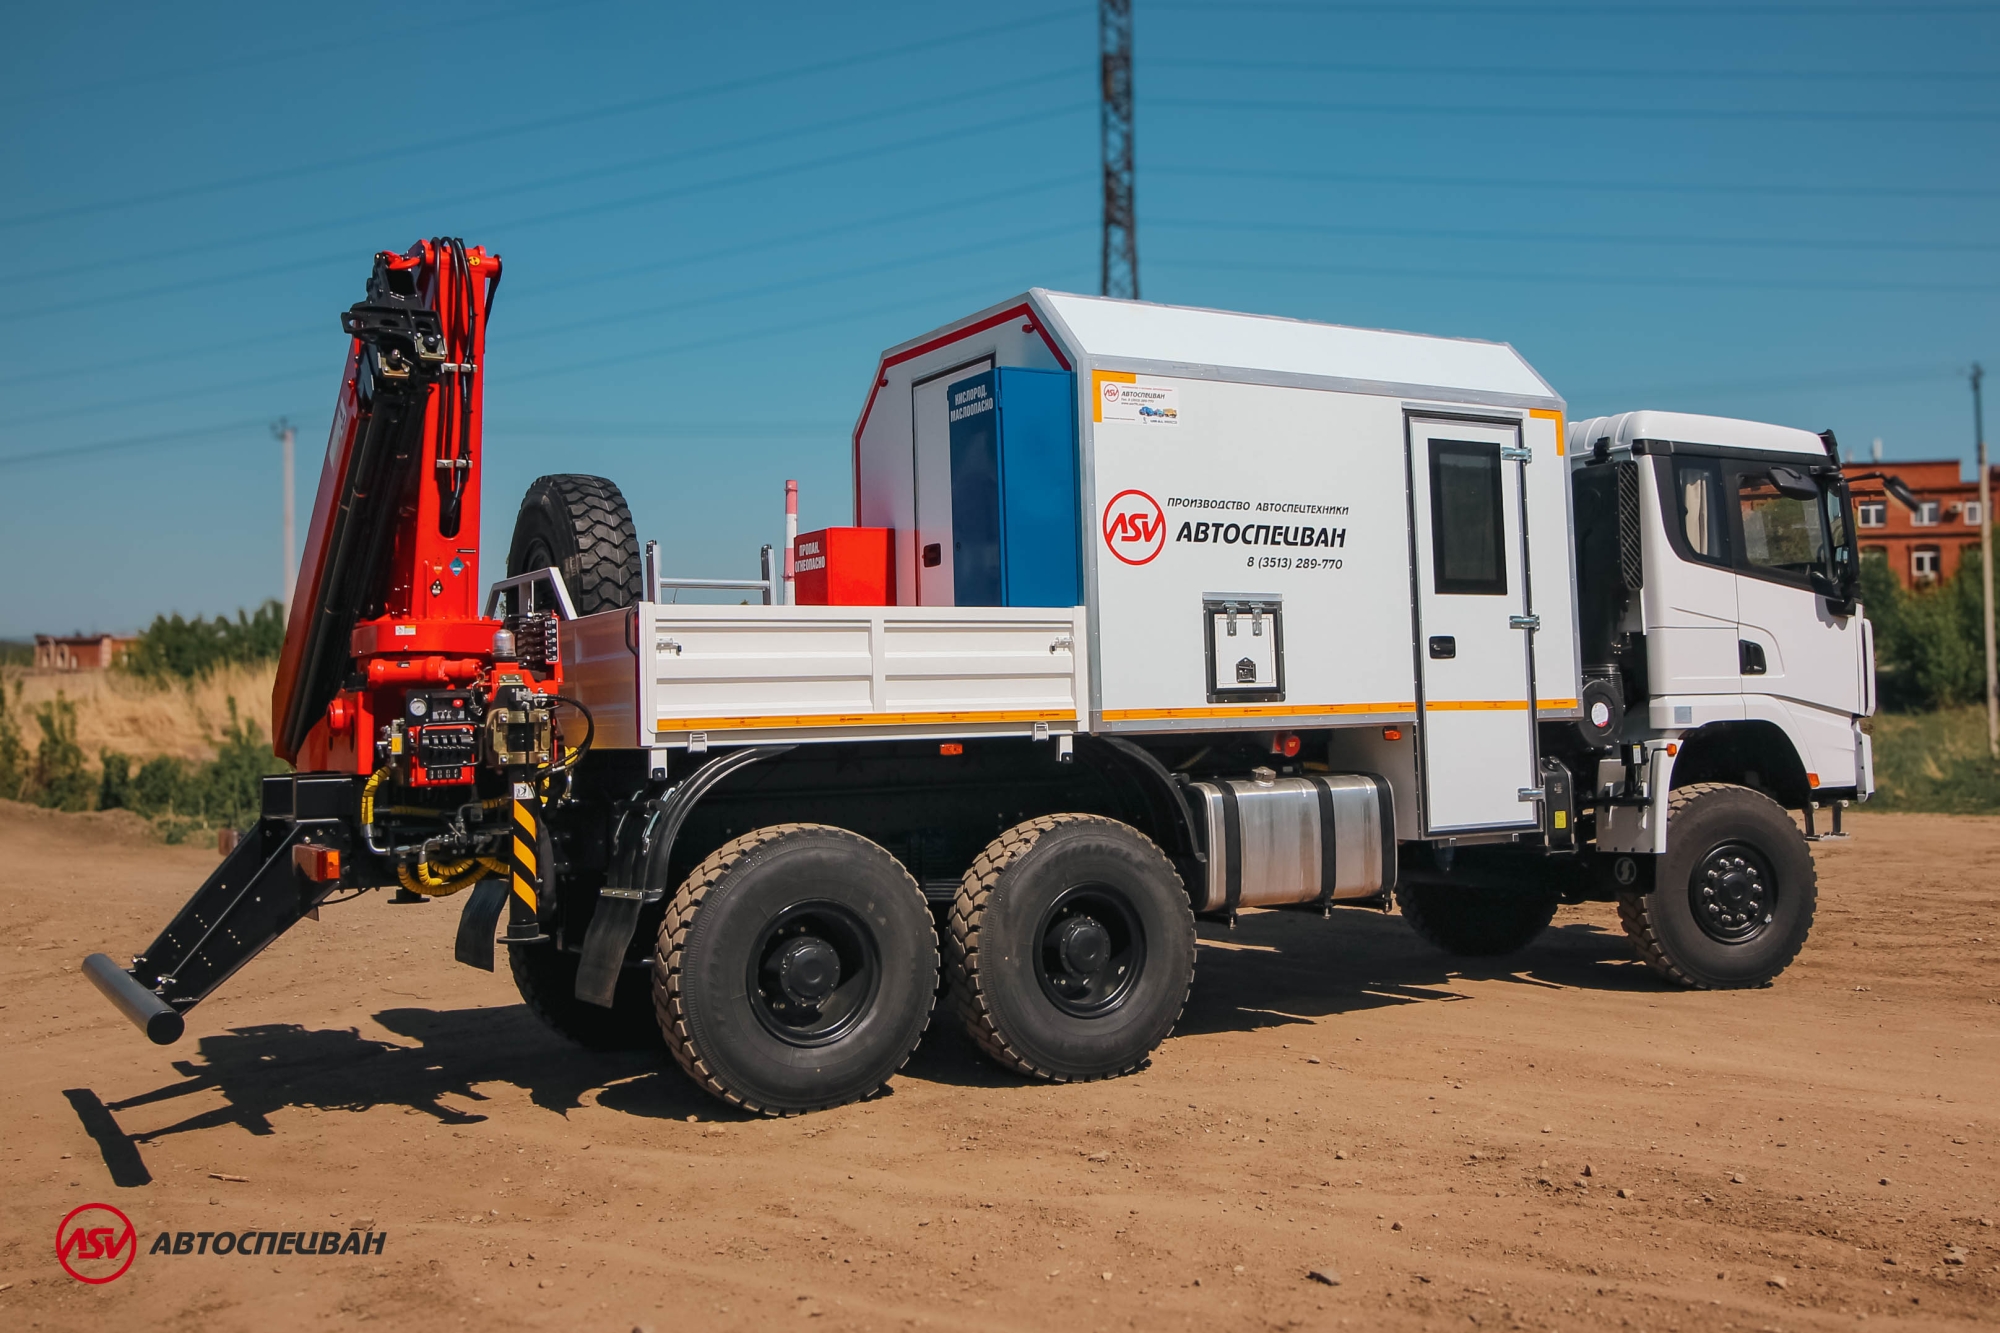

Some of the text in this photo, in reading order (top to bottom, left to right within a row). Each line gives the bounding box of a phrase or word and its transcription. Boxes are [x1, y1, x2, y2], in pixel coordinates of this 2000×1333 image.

[1121, 391, 1165, 400] АВТОСПЕЦВАН
[950, 397, 994, 423] МАСЛООПАСНО
[1167, 497, 1349, 516] ПРОИЗВОДСТВО АВТОСПЕЦТЕХНИКИ
[1175, 521, 1347, 548] АВТОСПЕЦВАН
[1246, 556, 1343, 570] 8 (3513) 289-770
